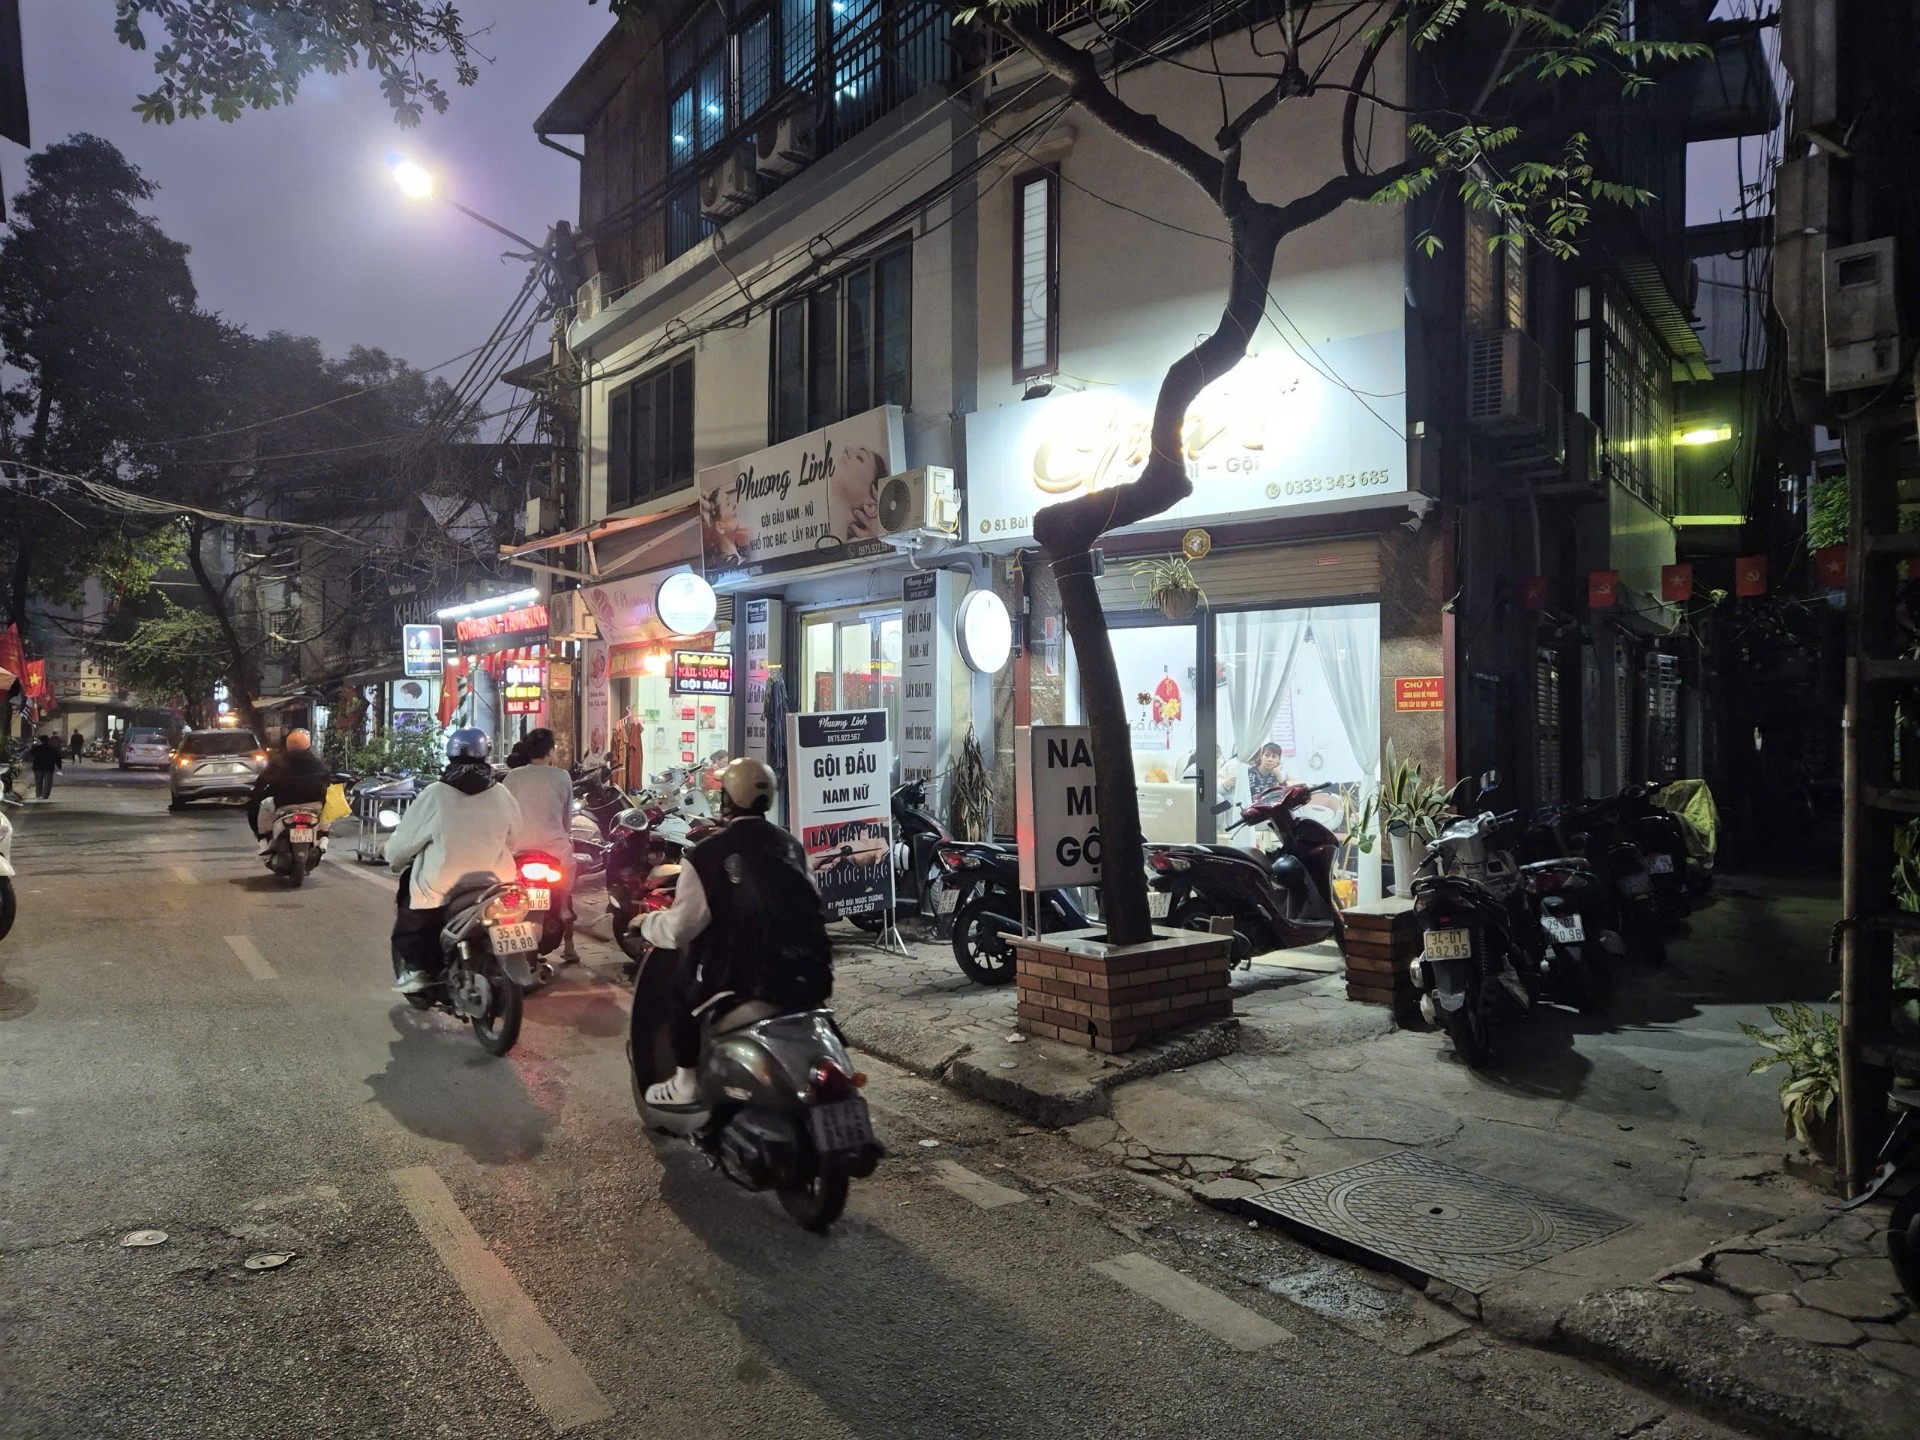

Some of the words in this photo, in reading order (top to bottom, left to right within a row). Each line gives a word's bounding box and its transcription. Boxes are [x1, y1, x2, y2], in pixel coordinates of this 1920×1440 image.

[736, 465, 791, 504] Phương
[798, 440, 835, 487] Linh
[1226, 455, 1259, 475] Gội
[1284, 477, 1322, 495] 0333
[1324, 473, 1356, 491] 343
[1360, 469, 1389, 487] 685
[761, 512, 771, 530] GỘI
[786, 506, 799, 521] NAM
[994, 519, 1007, 531] 81
[762, 533, 773, 549] TÓC
[775, 531, 787, 548] BẠC
[792, 525, 803, 542] LẤY
[806, 523, 818, 539] RÁY
[820, 521, 831, 537] TAI
[908, 610, 918, 638] GỘI
[909, 645, 919, 658] NAM
[680, 678, 701, 690] GỘI
[915, 679, 924, 698] RÁY
[850, 714, 868, 727] Linh
[827, 733, 861, 743] 0975.922.567
[1047, 737, 1093, 769] NA
[813, 754, 841, 782] GỘI
[844, 747, 877, 775] ĐẦU
[822, 788, 850, 804] NAM
[852, 783, 870, 801] NỮ
[867, 822, 883, 839] TAI
[838, 903, 875, 916] 0975.922.567
[496, 937, 534, 953] 378.80
[1428, 943, 1468, 958] 392.85
